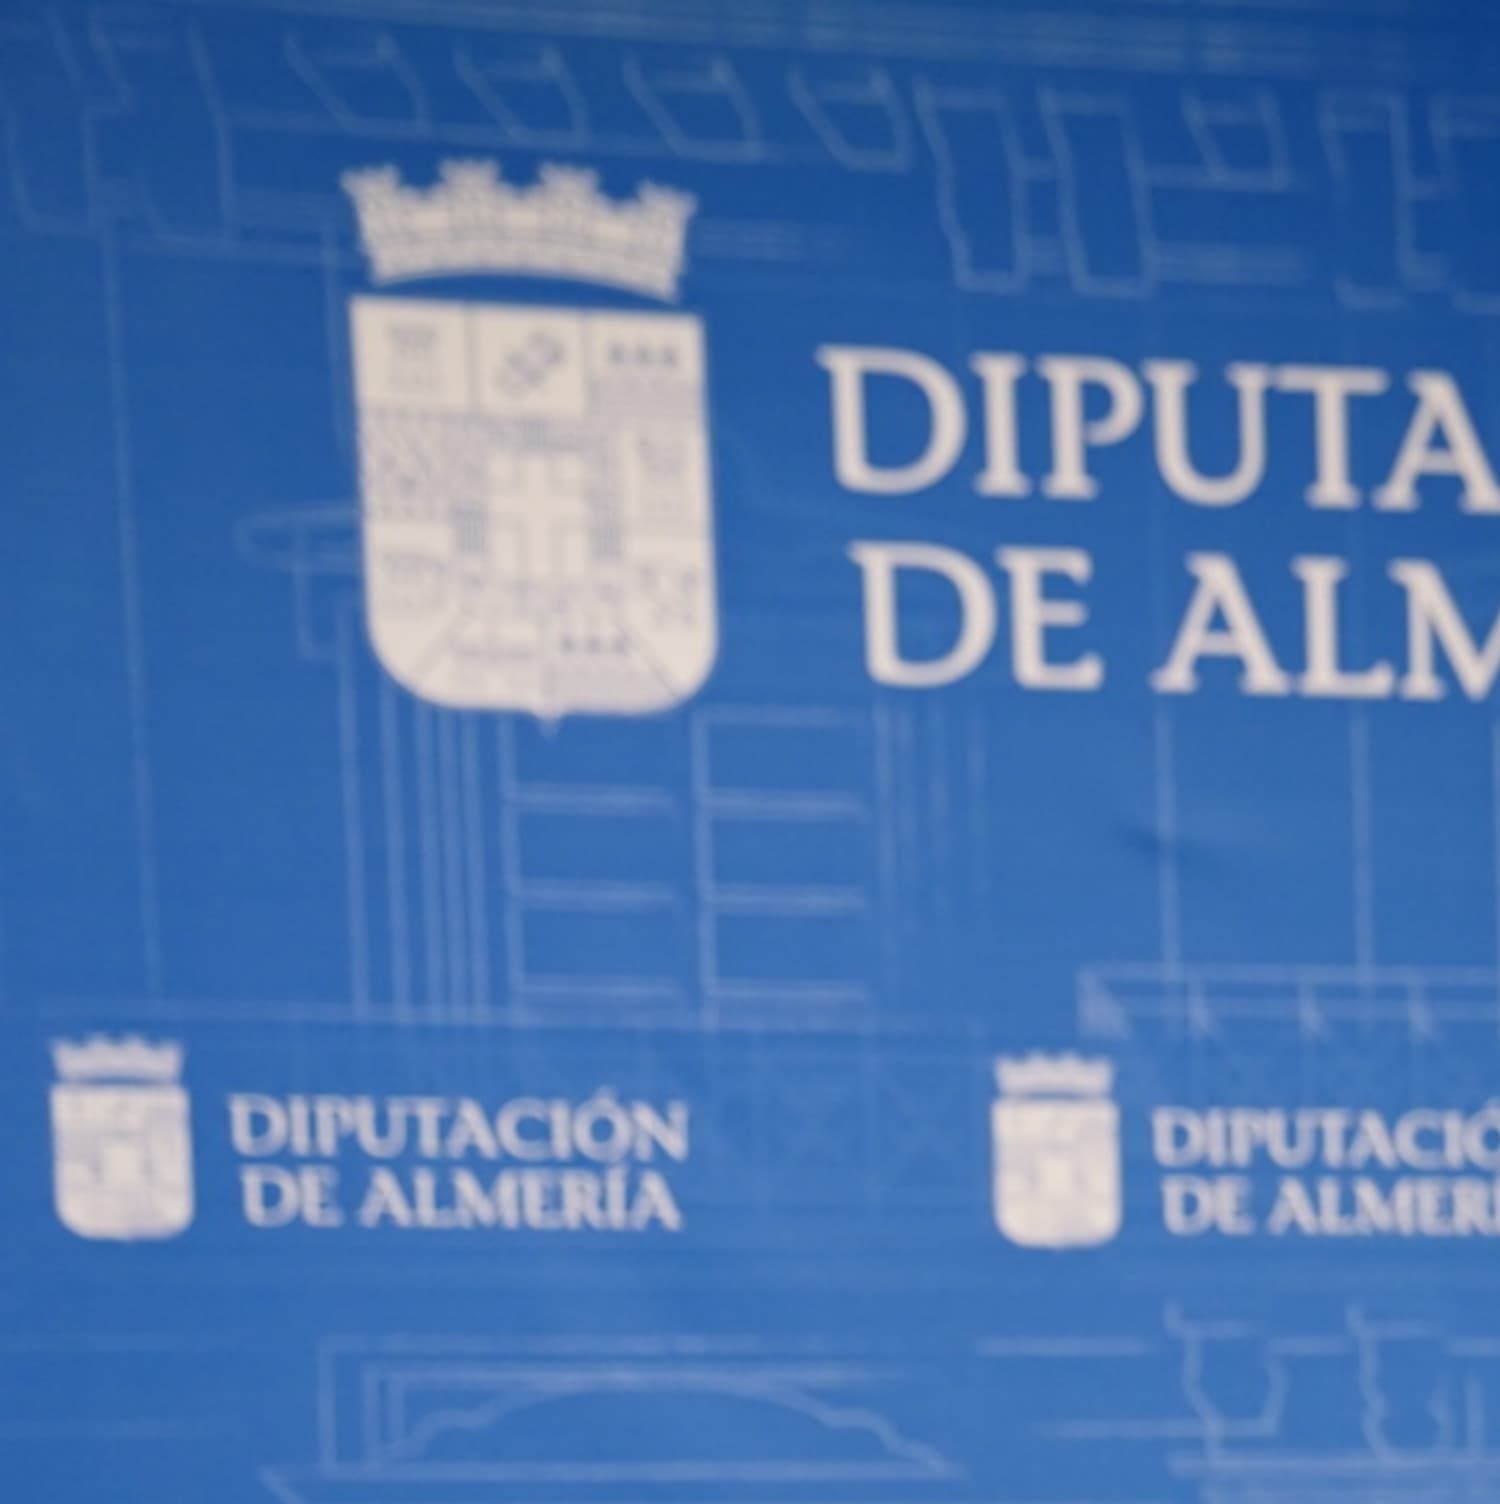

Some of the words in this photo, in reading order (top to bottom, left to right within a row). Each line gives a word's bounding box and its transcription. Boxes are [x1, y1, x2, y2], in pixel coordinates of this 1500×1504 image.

[848, 538, 1104, 690] DE
[228, 1087, 689, 1162] DIPUTACIÓN
[239, 1166, 343, 1228] DE
[360, 1160, 684, 1232] ALMERÍA
[1160, 1175, 1252, 1237] DE
